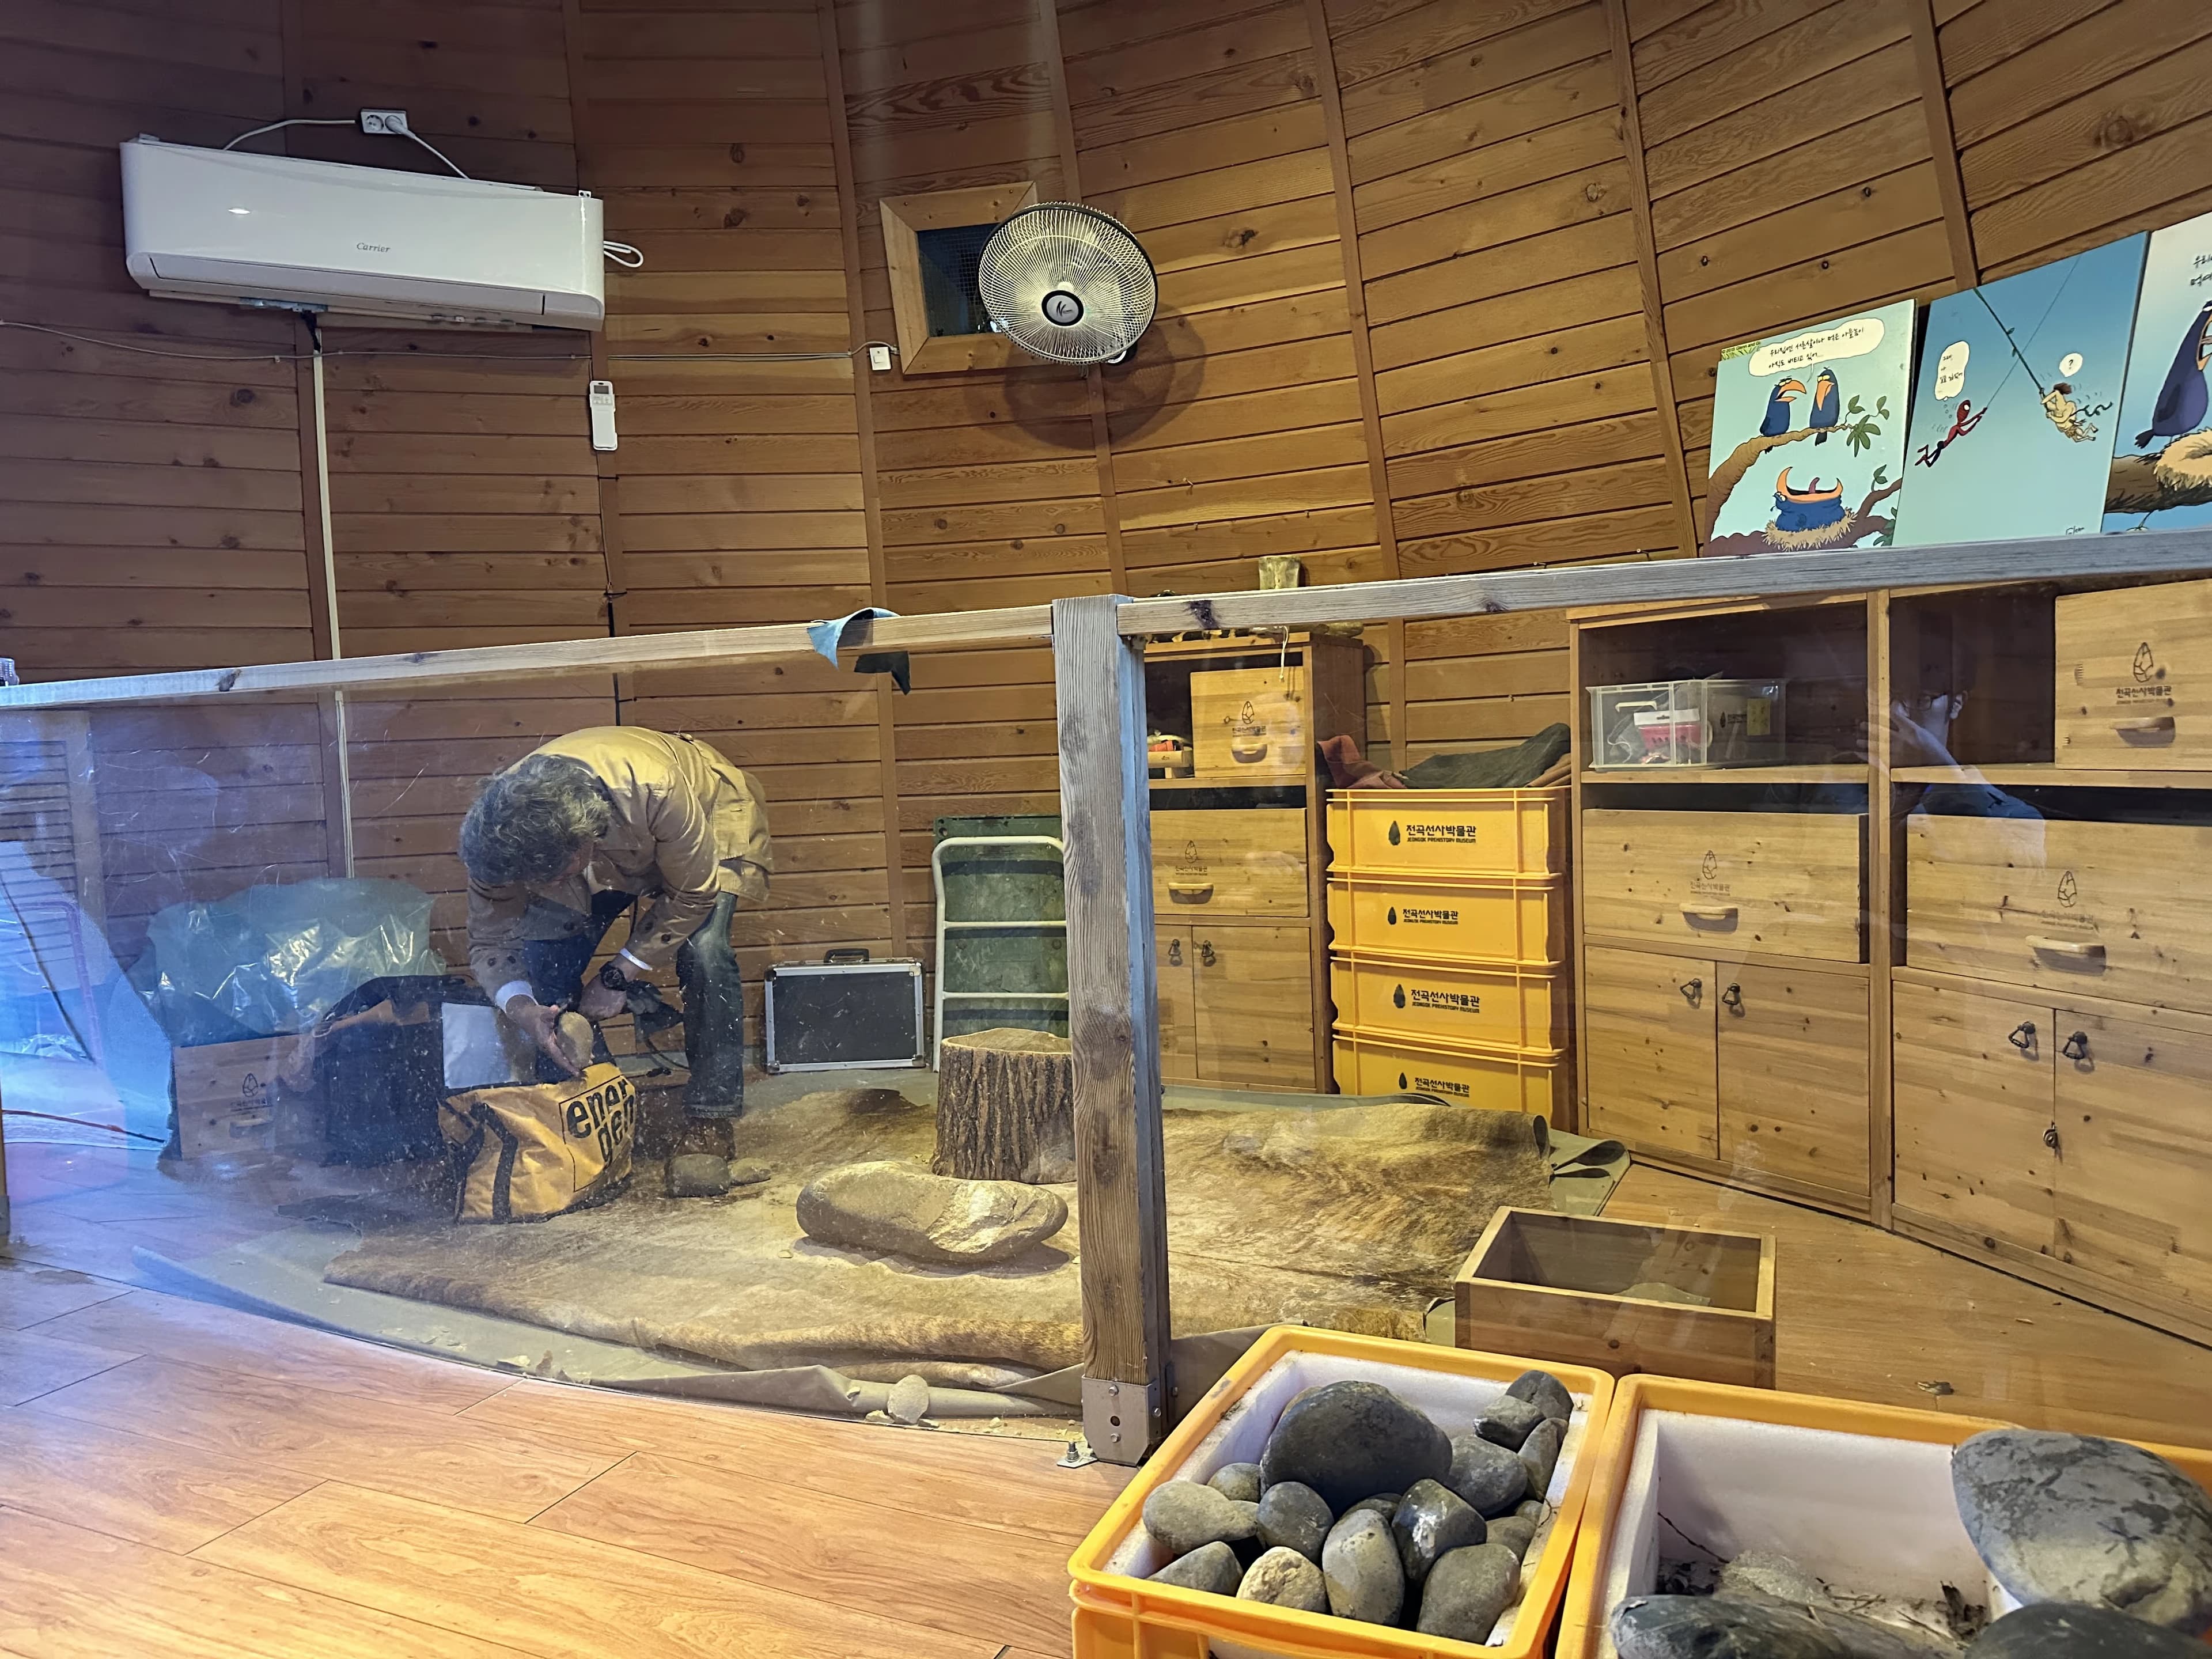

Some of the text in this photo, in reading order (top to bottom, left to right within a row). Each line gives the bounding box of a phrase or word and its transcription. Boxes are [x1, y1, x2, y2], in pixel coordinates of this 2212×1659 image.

[357, 242, 391, 252] Carrier
[1769, 360, 1785, 368] 아직도
[1406, 824, 1476, 837] 전곡선사박물관
[1403, 908, 1459, 920] 전곡선사박물관
[1411, 989, 1480, 1007] 전곡선사박물관
[1415, 1077, 1470, 1093] 전곡선사박물관
[566, 1078, 628, 1138] ener
